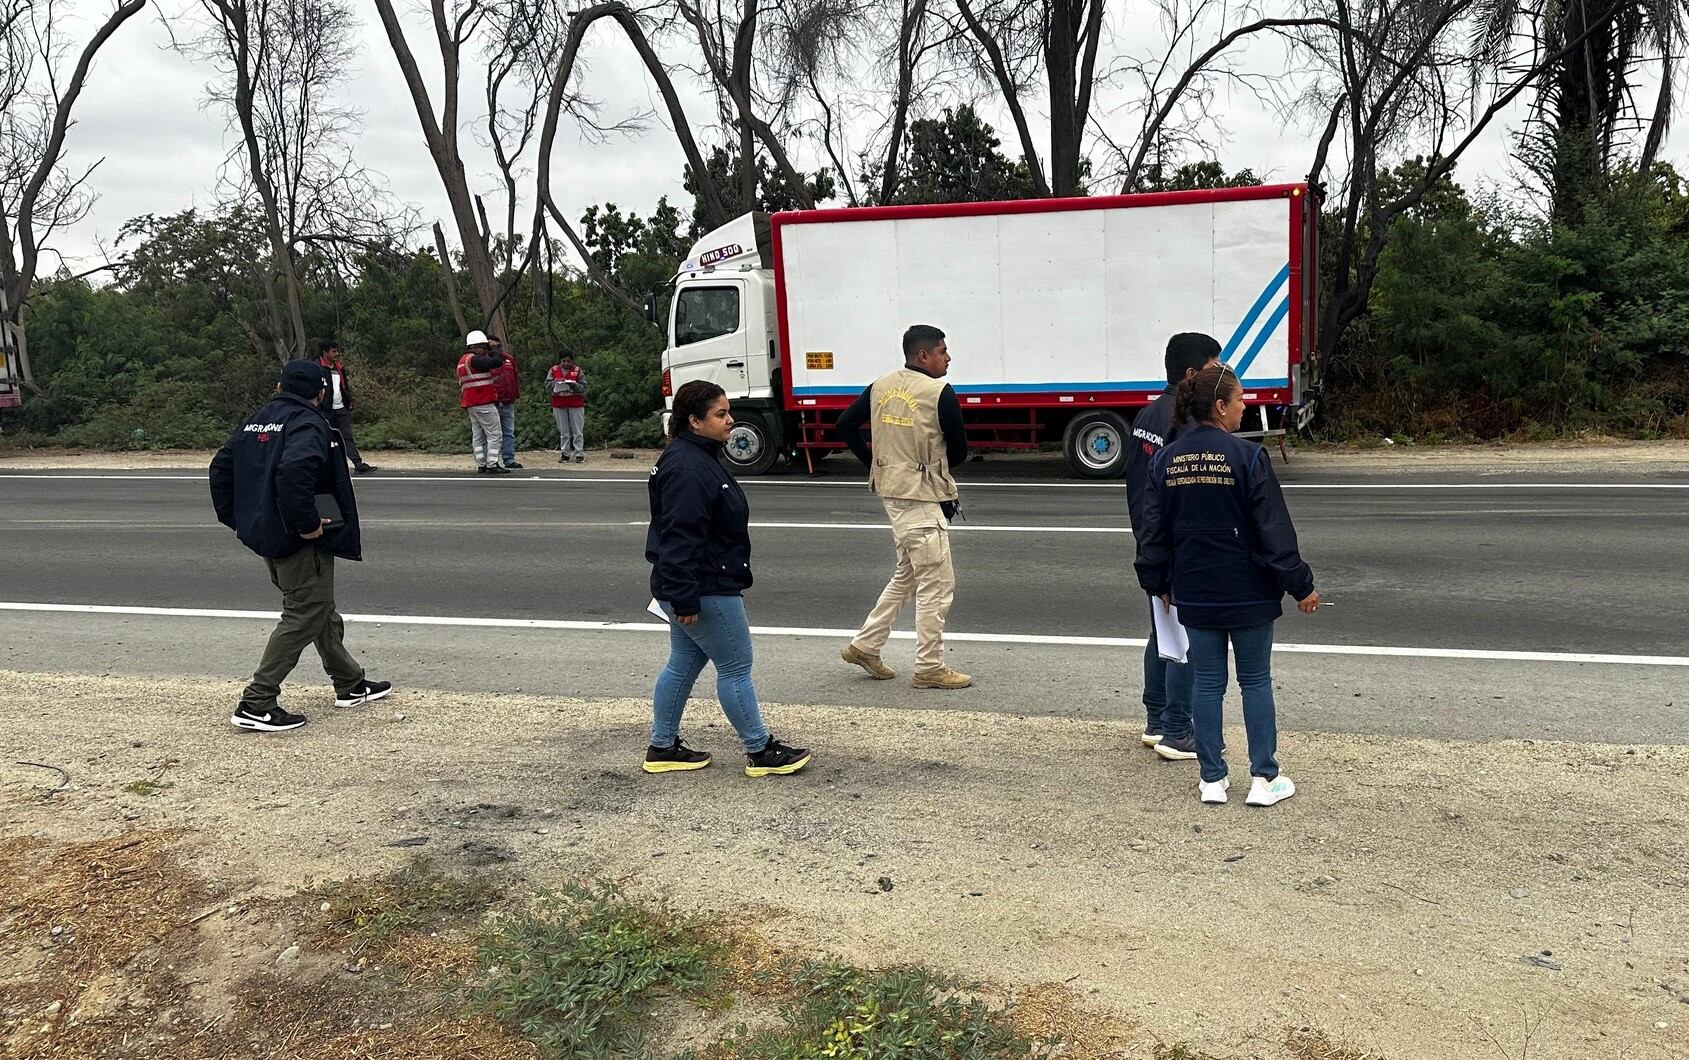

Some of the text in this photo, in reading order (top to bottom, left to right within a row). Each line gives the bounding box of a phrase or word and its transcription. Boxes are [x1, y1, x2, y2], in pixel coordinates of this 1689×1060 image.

[701, 244, 739, 263] HINO 500
[1172, 450, 1225, 463] MINISTERIO PÚBLICO
[1166, 463, 1189, 475] FISCALÍA
[1200, 464, 1207, 472] LA
[1208, 462, 1232, 473] NACIÓN
